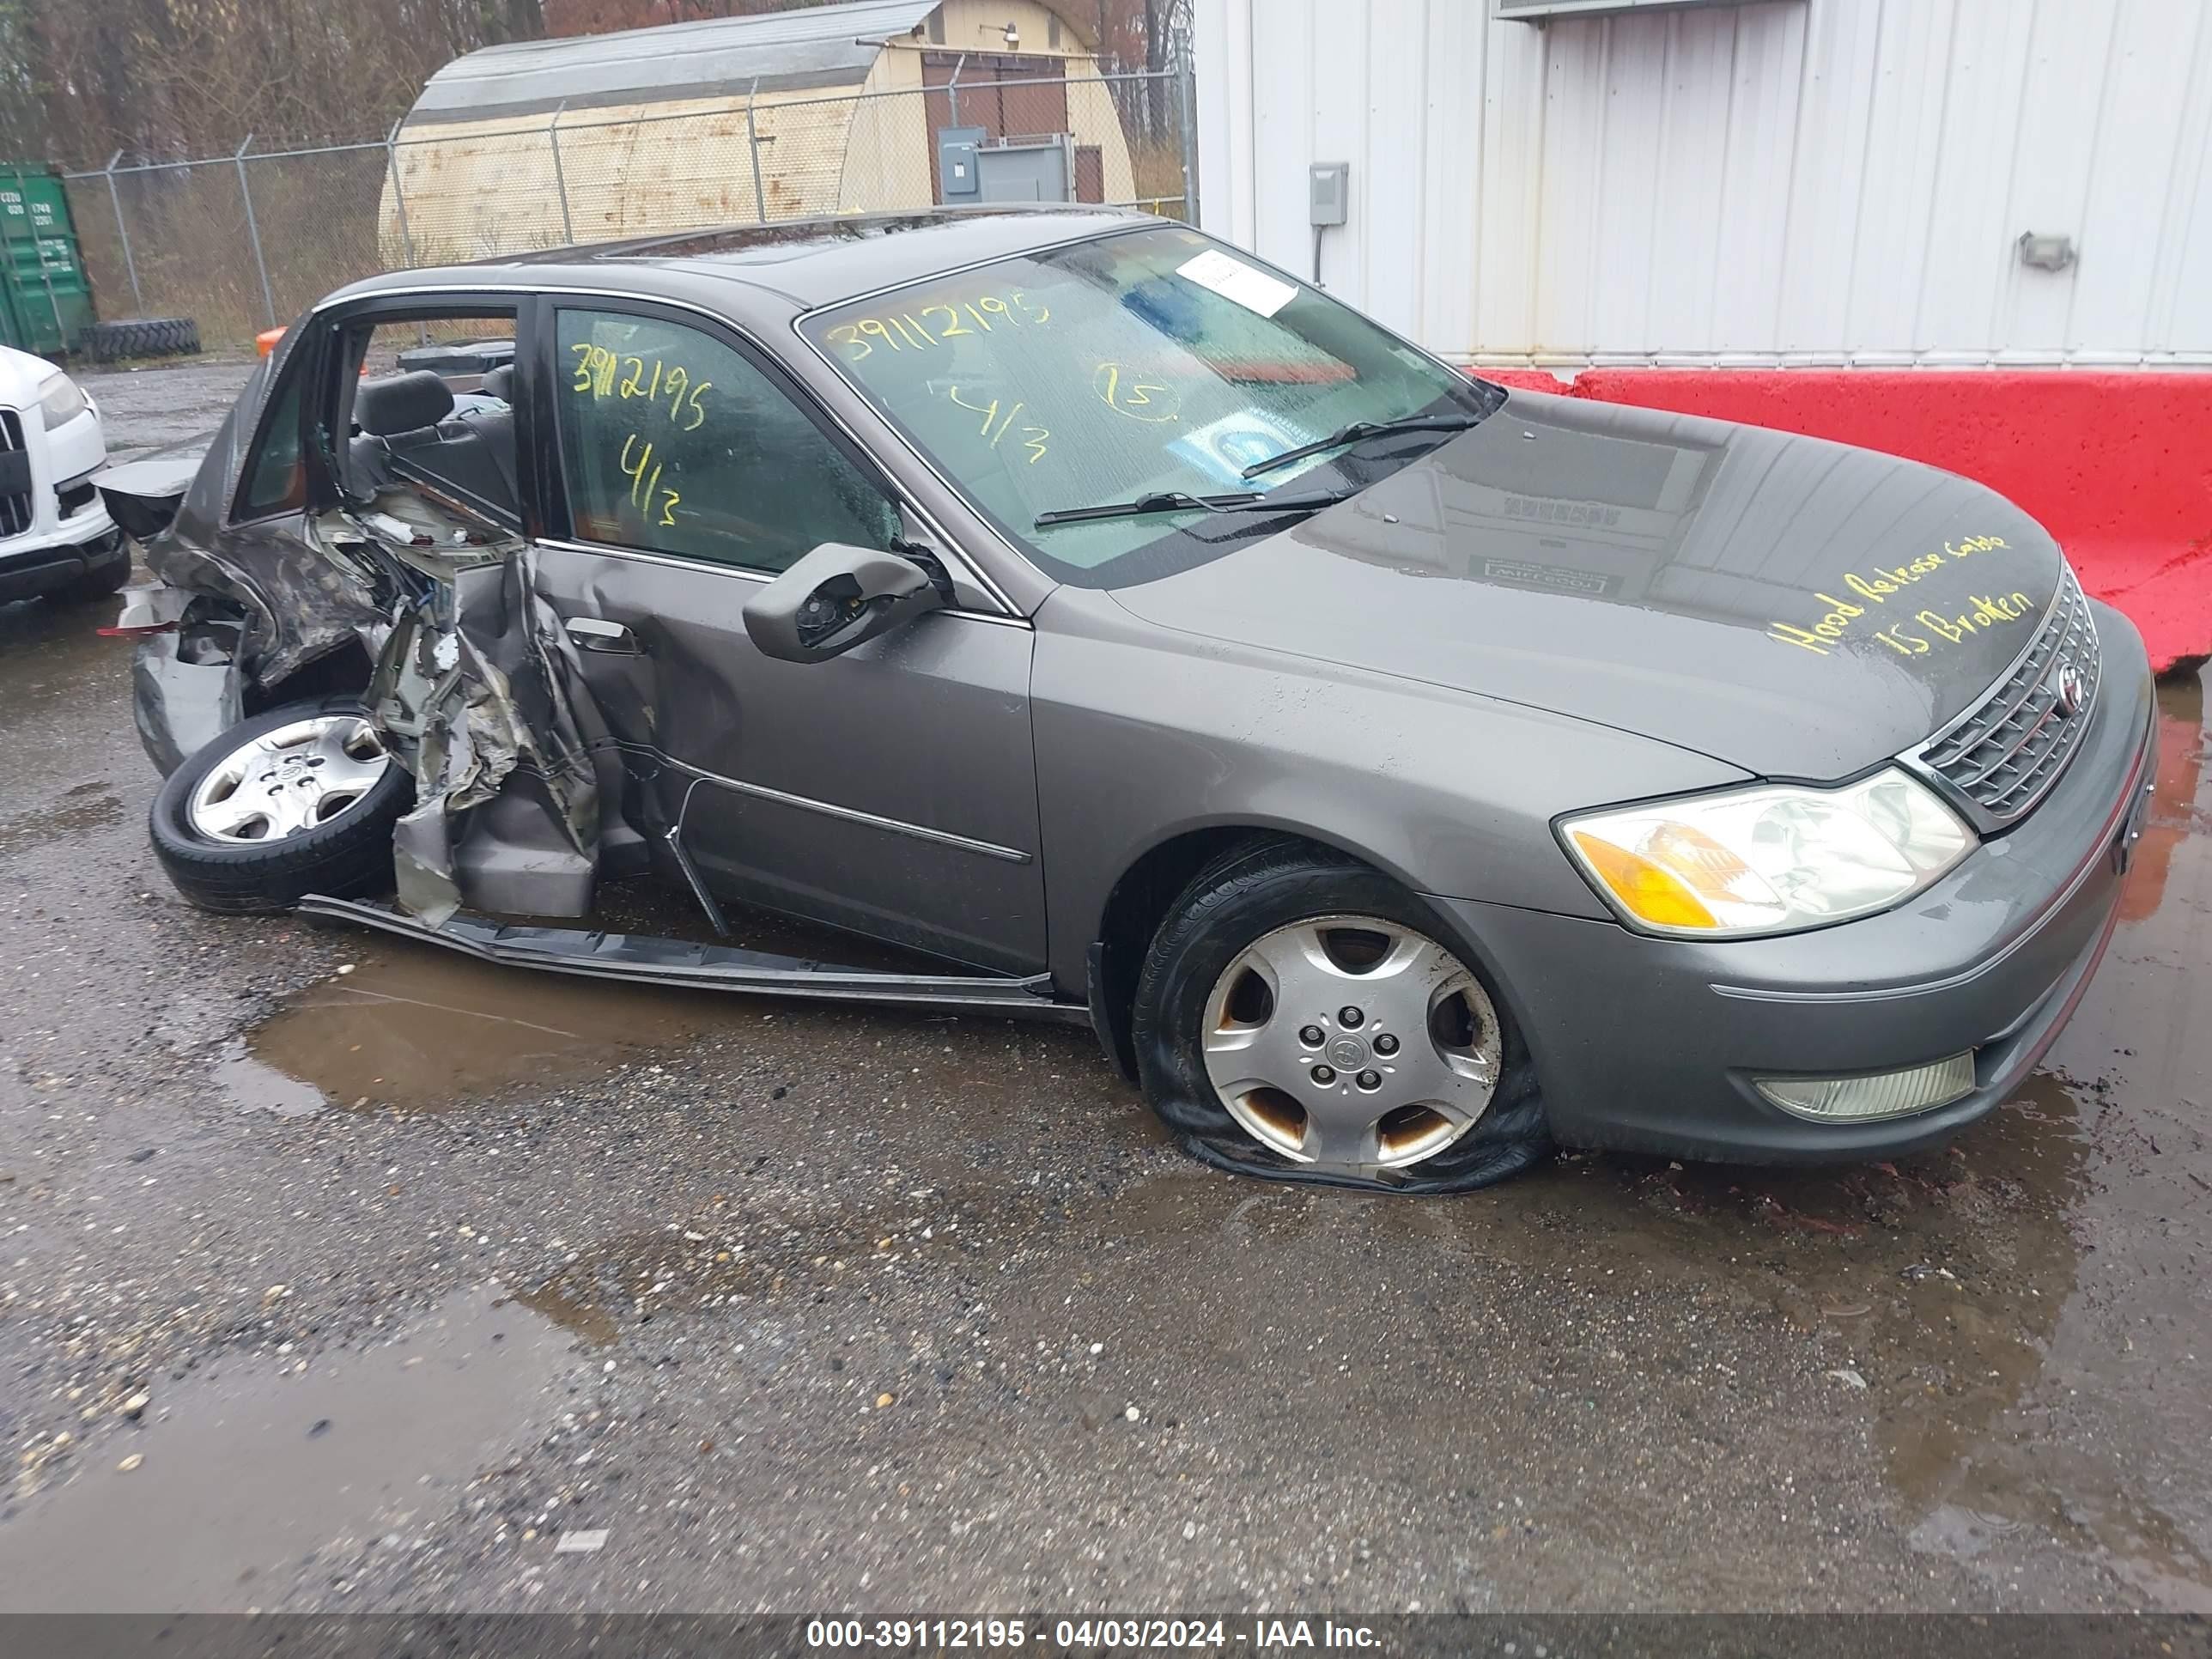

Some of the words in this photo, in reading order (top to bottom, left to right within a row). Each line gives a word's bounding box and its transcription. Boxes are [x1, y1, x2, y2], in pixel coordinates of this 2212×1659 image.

[827, 293, 1050, 362] 39112195
[951, 386, 1049, 464] 4/3
[620, 433, 681, 526] 4/3
[1766, 592, 1865, 655] Hood
[1844, 553, 1947, 604] Release
[1915, 592, 2034, 644] Broken
